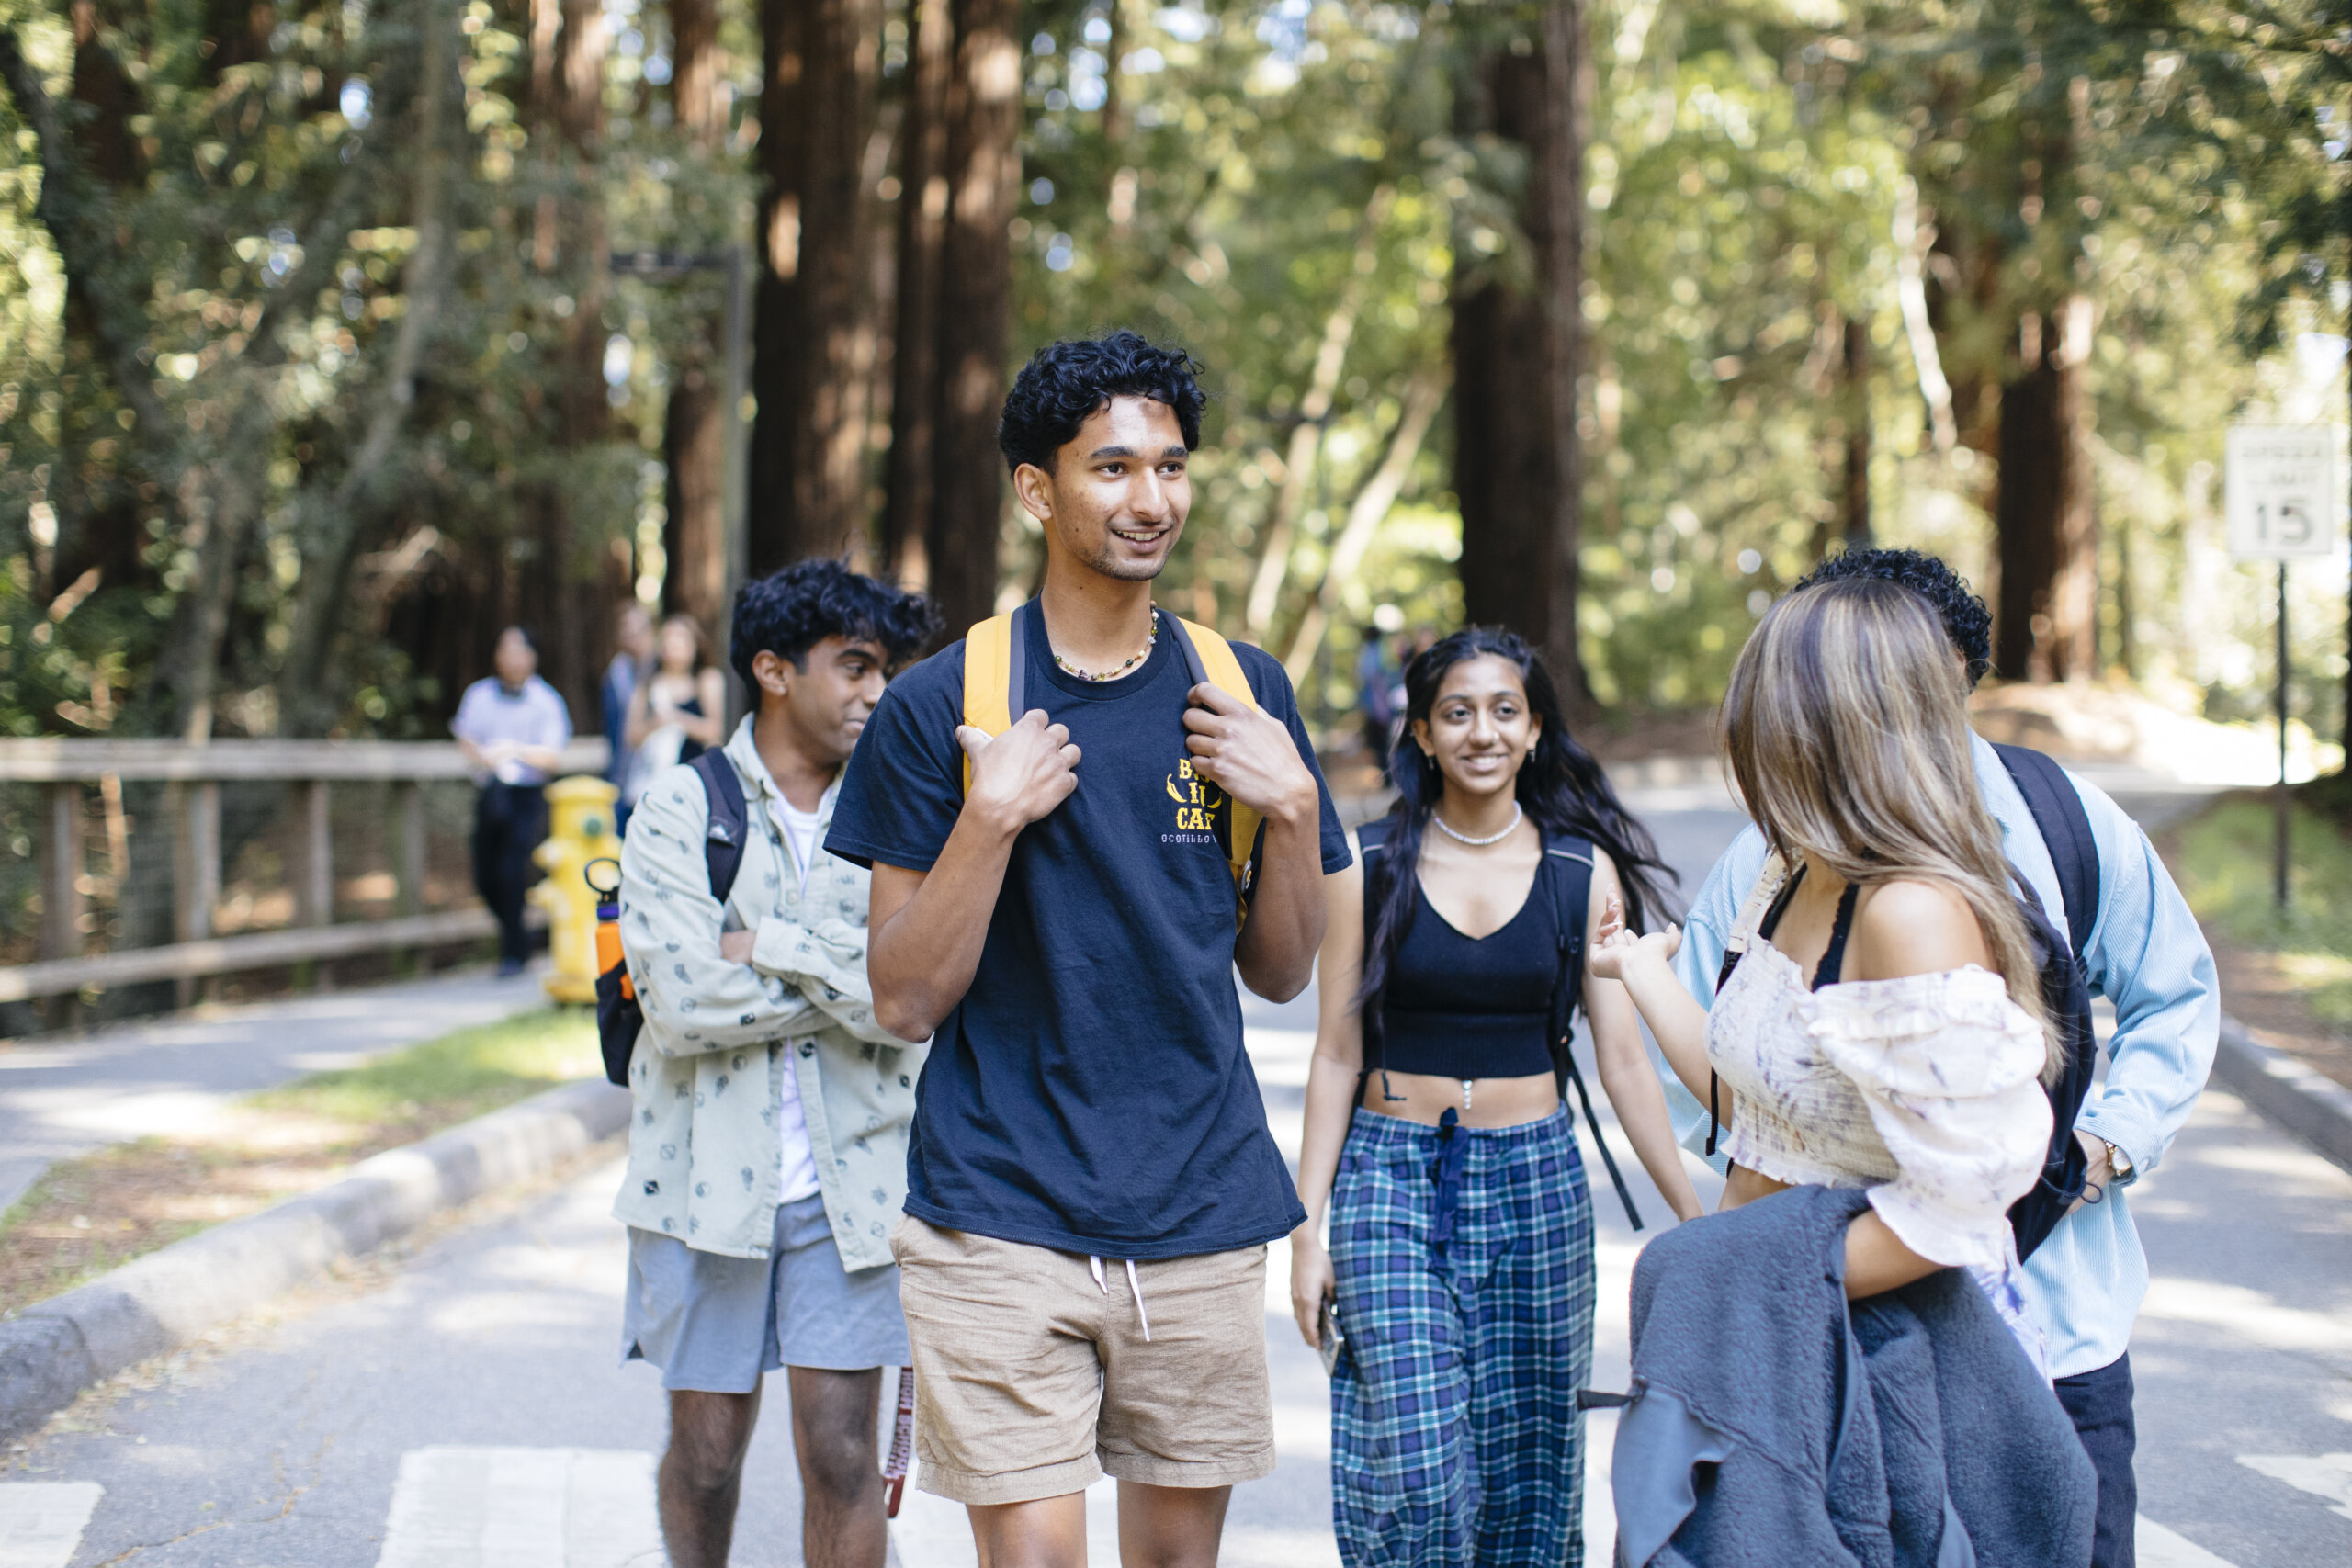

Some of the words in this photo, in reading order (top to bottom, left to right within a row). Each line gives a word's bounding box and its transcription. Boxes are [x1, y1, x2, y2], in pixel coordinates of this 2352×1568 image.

[2256, 497, 2314, 545] 15
[1161, 833, 1210, 843] OCOTILLO
[895, 1415, 911, 1477] SCHOOL
